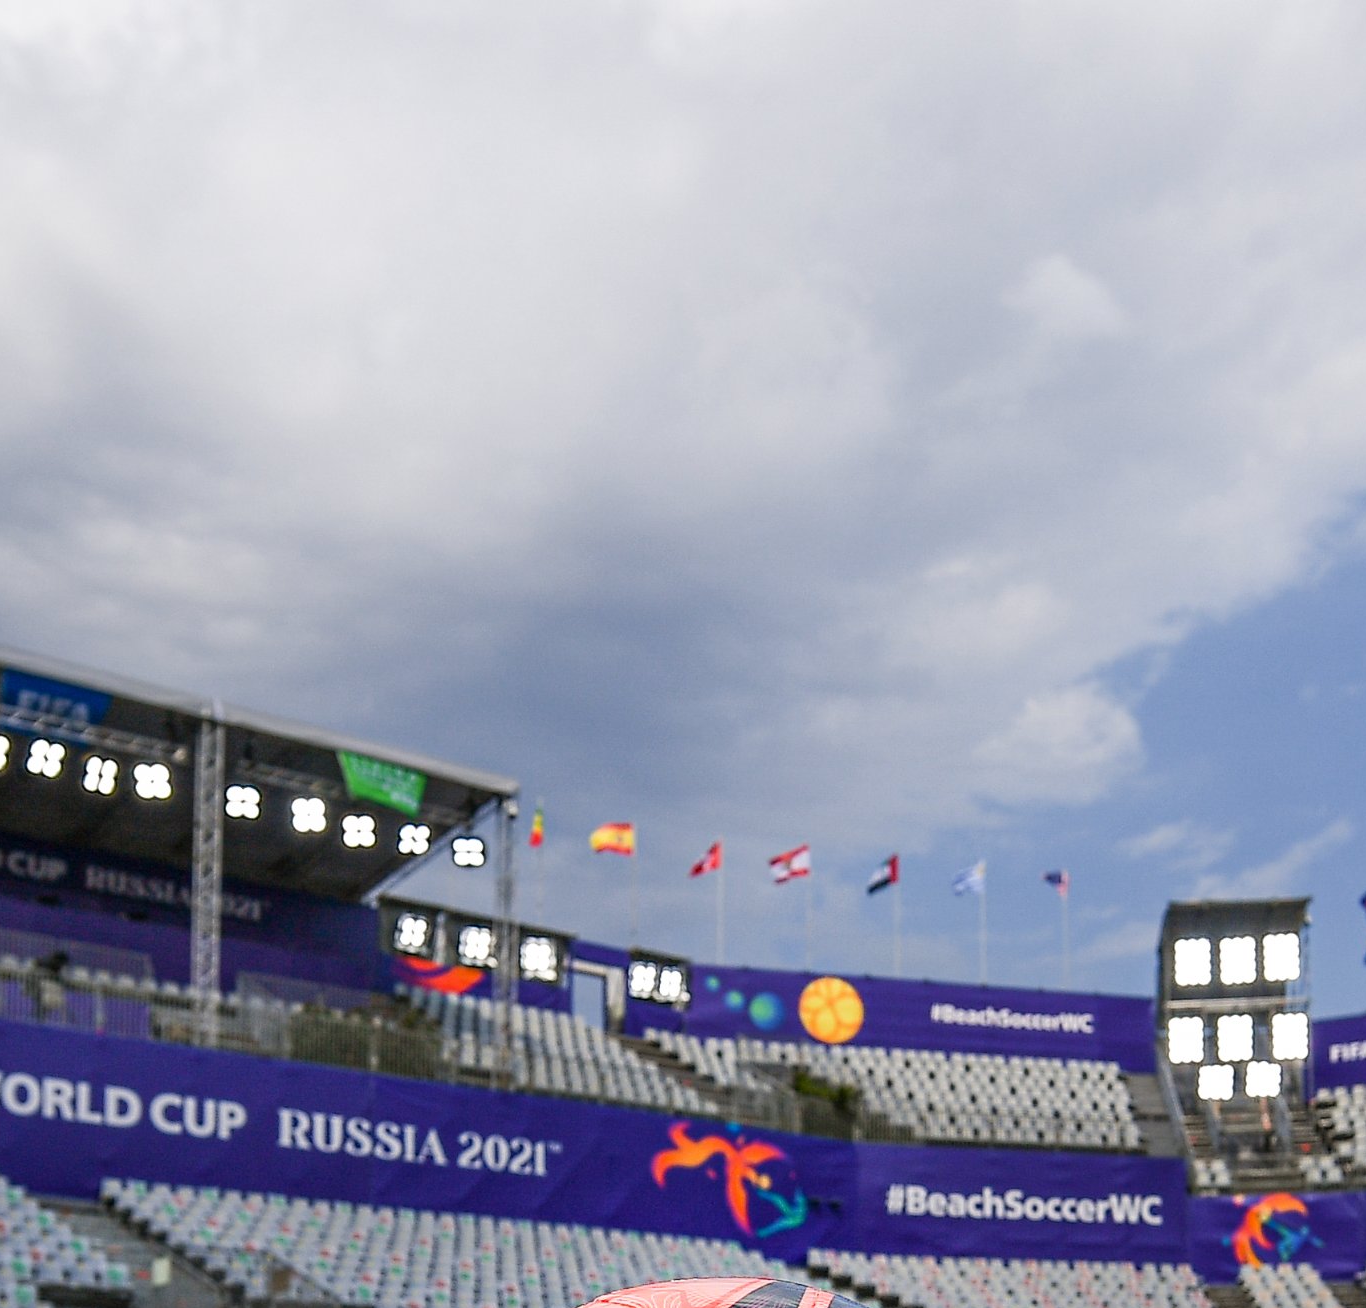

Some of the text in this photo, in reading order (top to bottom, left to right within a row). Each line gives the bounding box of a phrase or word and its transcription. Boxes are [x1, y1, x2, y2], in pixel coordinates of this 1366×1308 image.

[6, 850, 67, 882] CUP
[930, 1003, 1095, 1034] #BeachSoccerWC
[149, 1092, 247, 1140] CUP
[278, 1108, 447, 1166] RUSSIA
[885, 1184, 1163, 1226] #BeachSoccerWC
